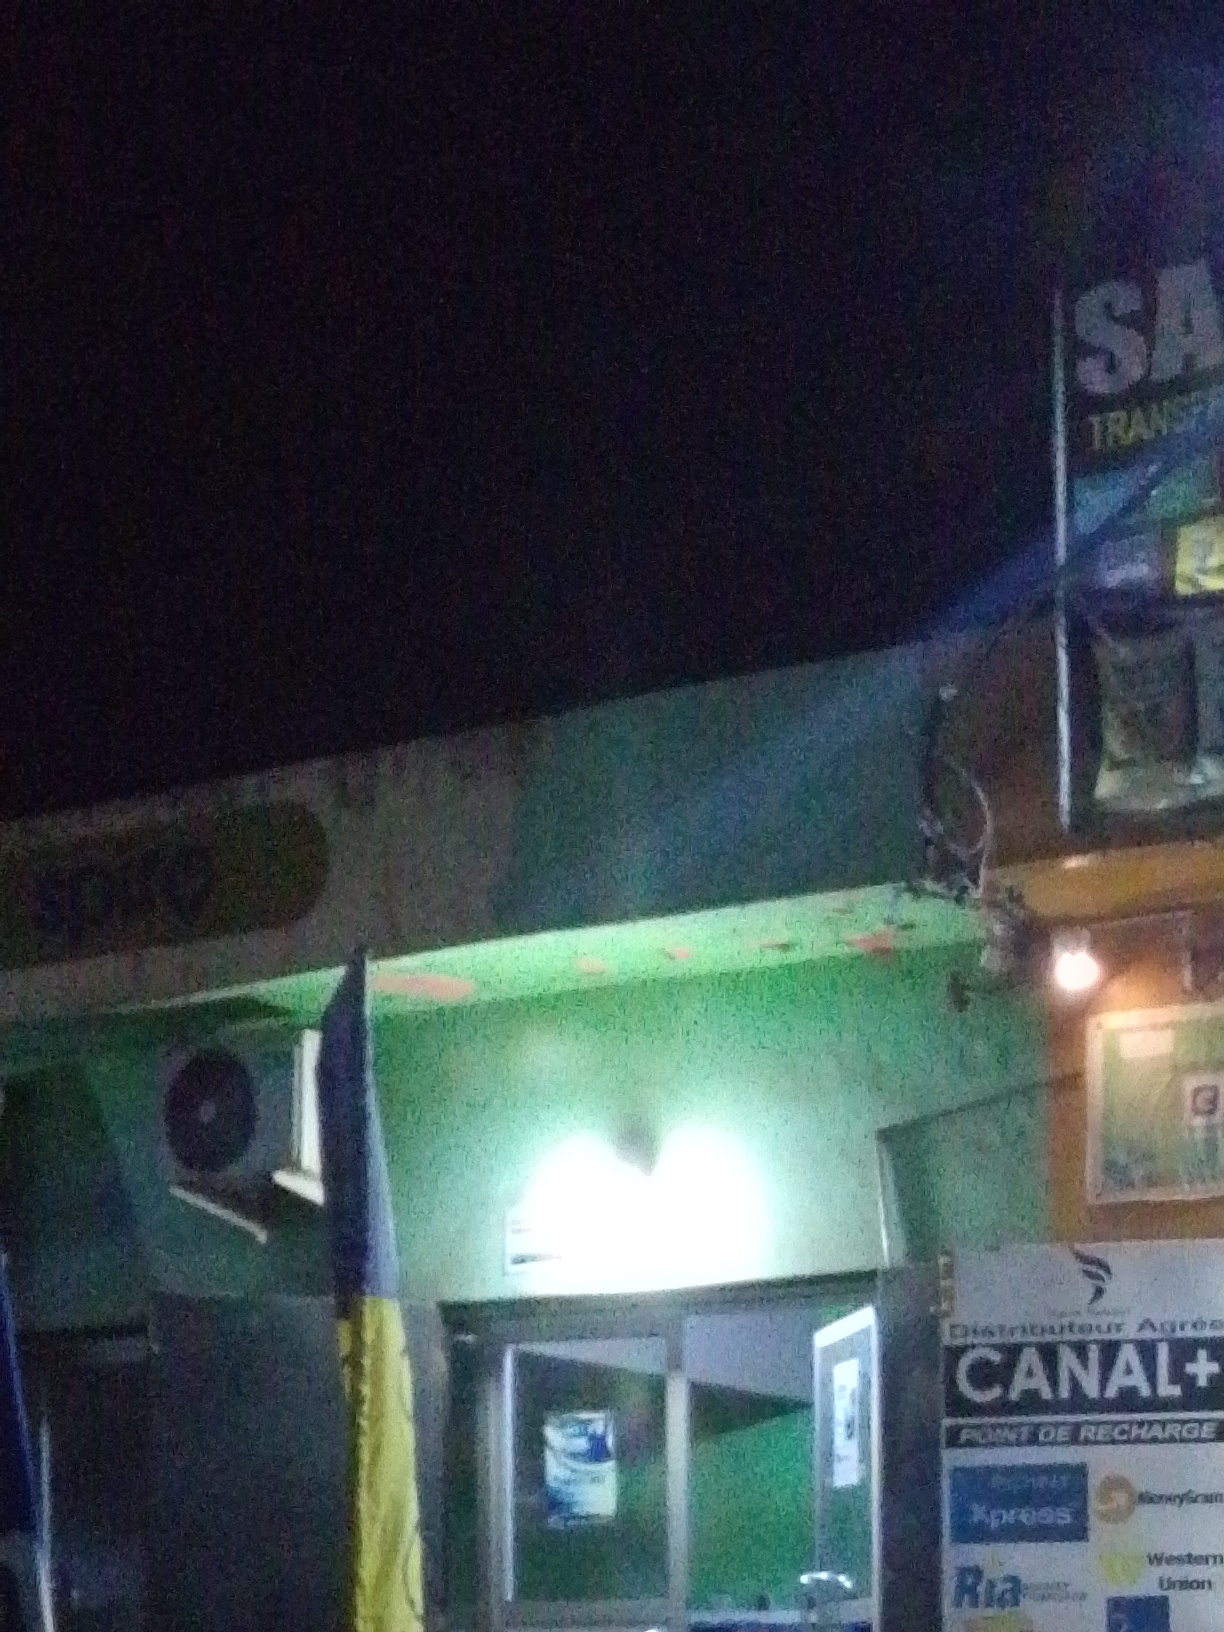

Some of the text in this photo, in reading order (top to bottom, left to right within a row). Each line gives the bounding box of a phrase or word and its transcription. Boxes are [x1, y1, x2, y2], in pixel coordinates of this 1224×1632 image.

[949, 1320, 1128, 1340] Distributeur
[955, 1340, 1222, 1405] CANAL+
[957, 1421, 1218, 1444] POINT DE RECHARGE
[1147, 1551, 1224, 1567] Western
[954, 1562, 1024, 1610] Ria
[1158, 1576, 1214, 1593] Union
